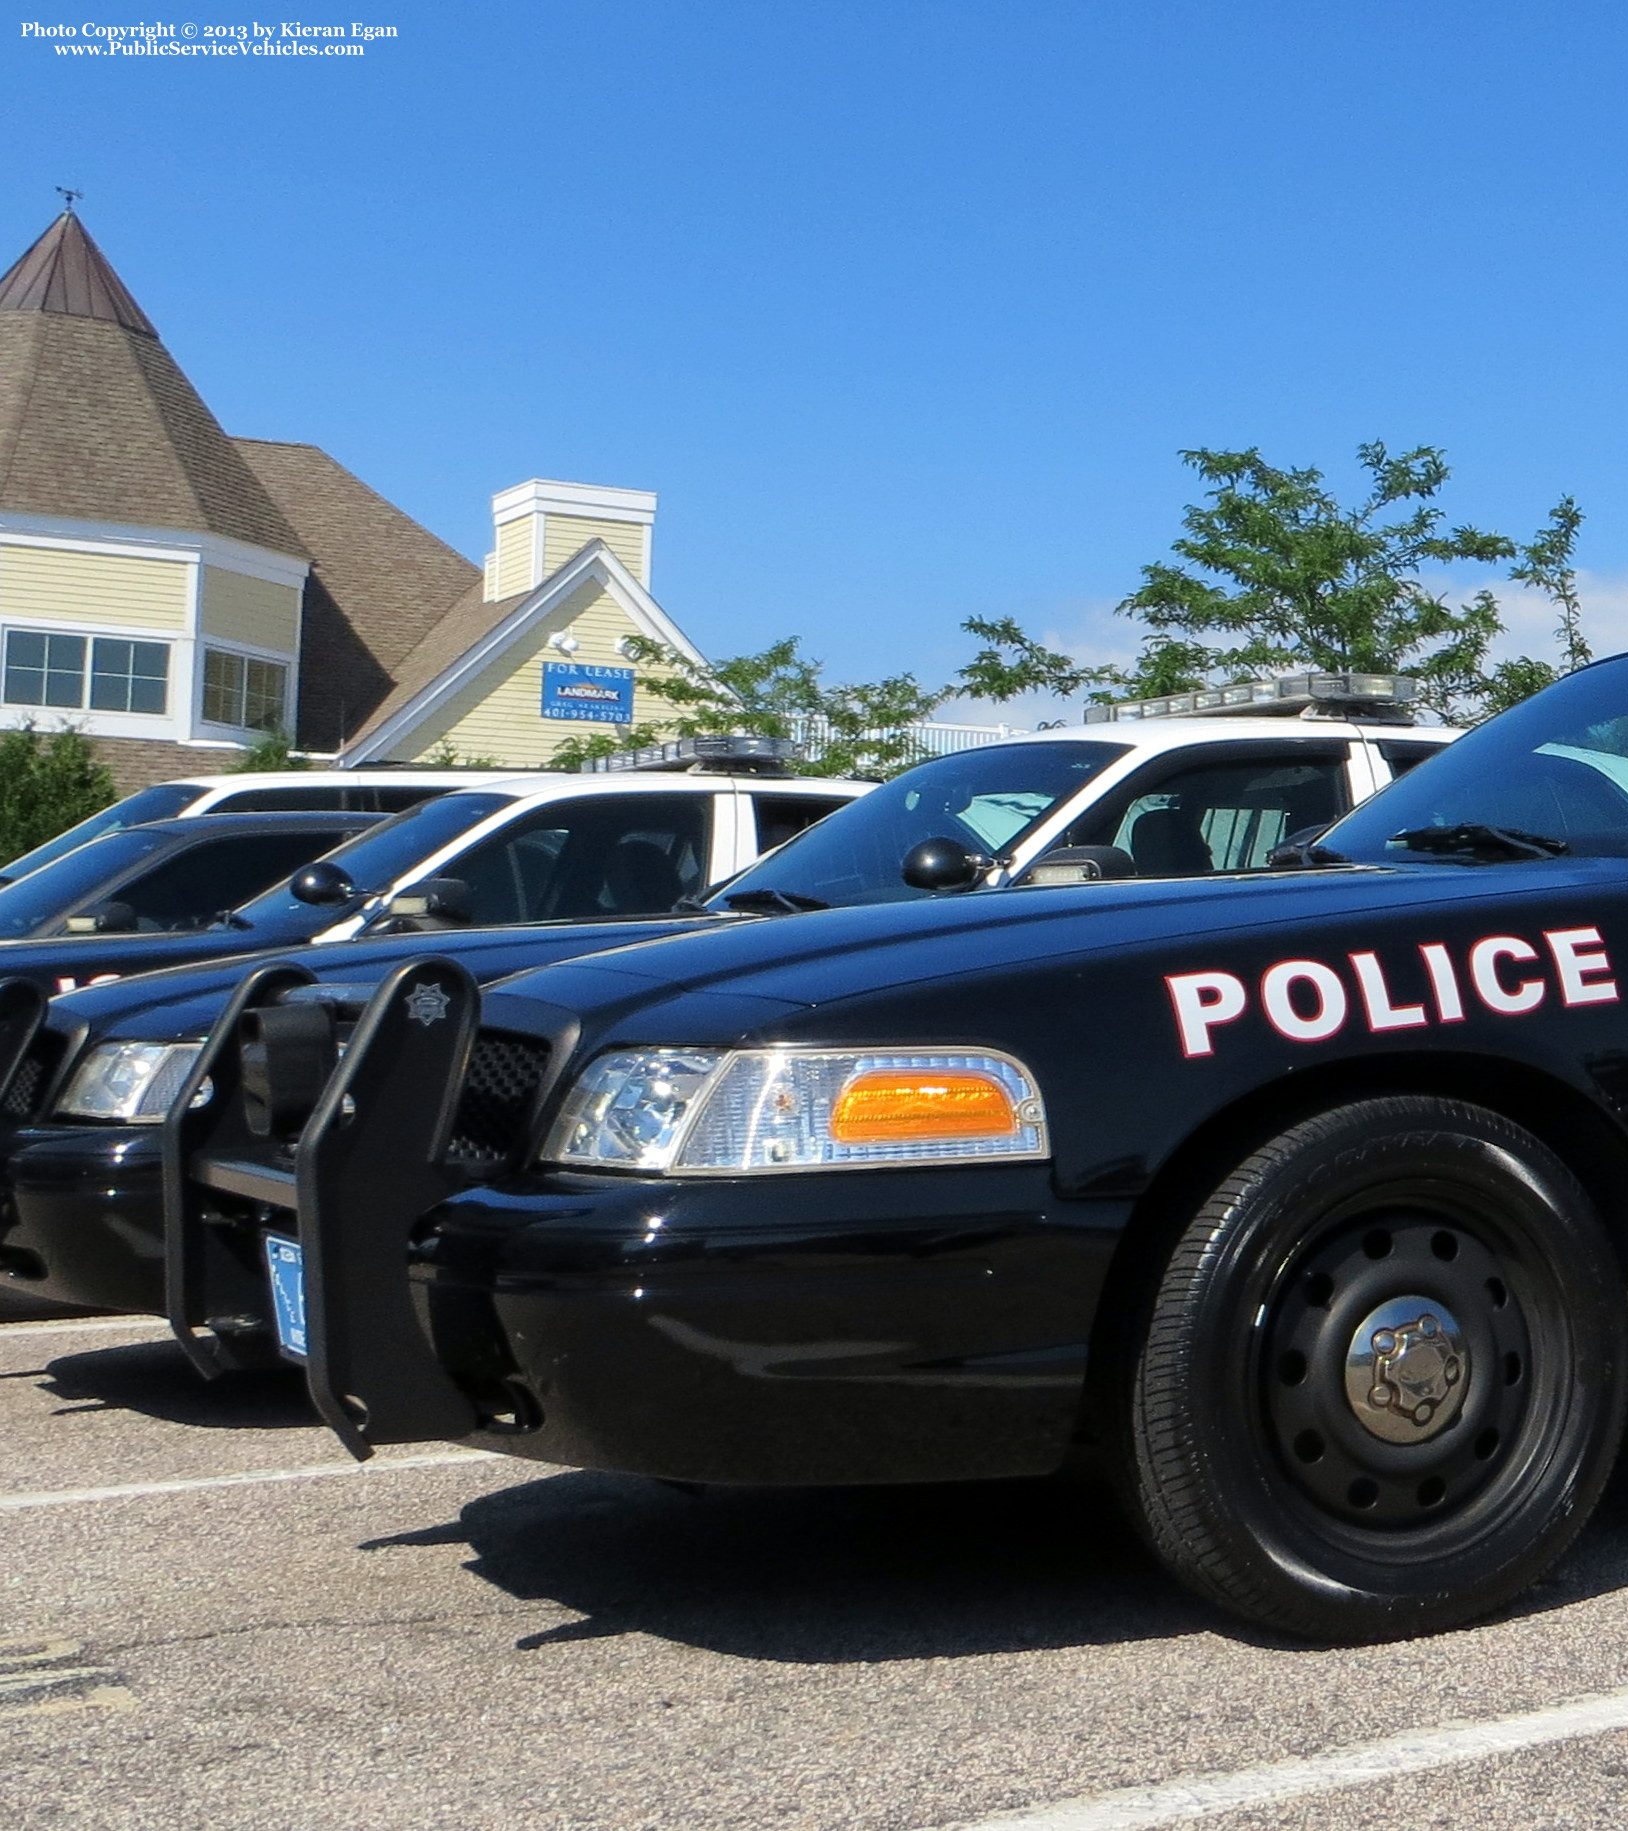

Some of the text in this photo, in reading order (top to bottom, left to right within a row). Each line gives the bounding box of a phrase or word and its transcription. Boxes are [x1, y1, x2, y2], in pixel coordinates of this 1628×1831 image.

[547, 662, 631, 679] FOR LEASE
[557, 687, 620, 700] LANDMARK
[1164, 926, 1620, 1058] POLICE
